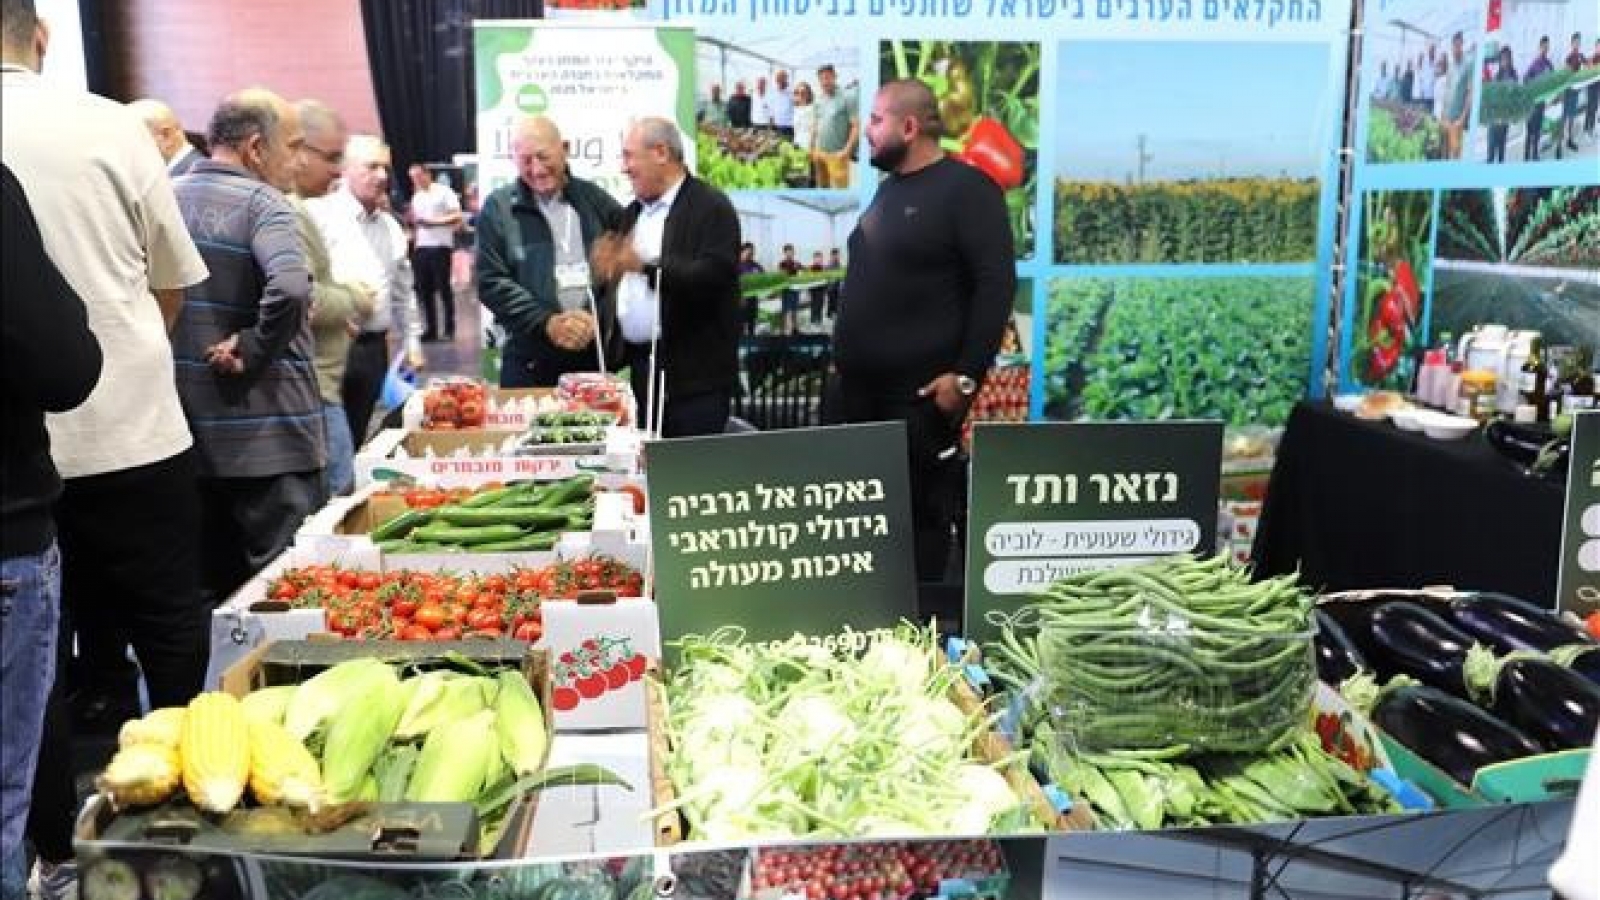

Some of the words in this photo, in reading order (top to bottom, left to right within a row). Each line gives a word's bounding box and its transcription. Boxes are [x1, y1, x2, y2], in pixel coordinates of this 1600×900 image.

[869, 0, 973, 17] שותפים
[986, 0, 1085, 20] בישראל
[1096, 0, 1192, 21] הערבים
[755, 483, 797, 510] אל
[803, 478, 886, 511] באקה
[1006, 473, 1079, 505] ותד
[1089, 471, 1178, 503] נזאר
[668, 490, 750, 519] גרביה
[668, 520, 800, 554] קולוראבי
[806, 514, 889, 541] גידולי
[991, 529, 1043, 552] לוביה
[1063, 527, 1138, 551] שעועית
[1142, 524, 1195, 548] גידולי
[690, 560, 784, 590] מעולה
[790, 550, 874, 580] איכות
